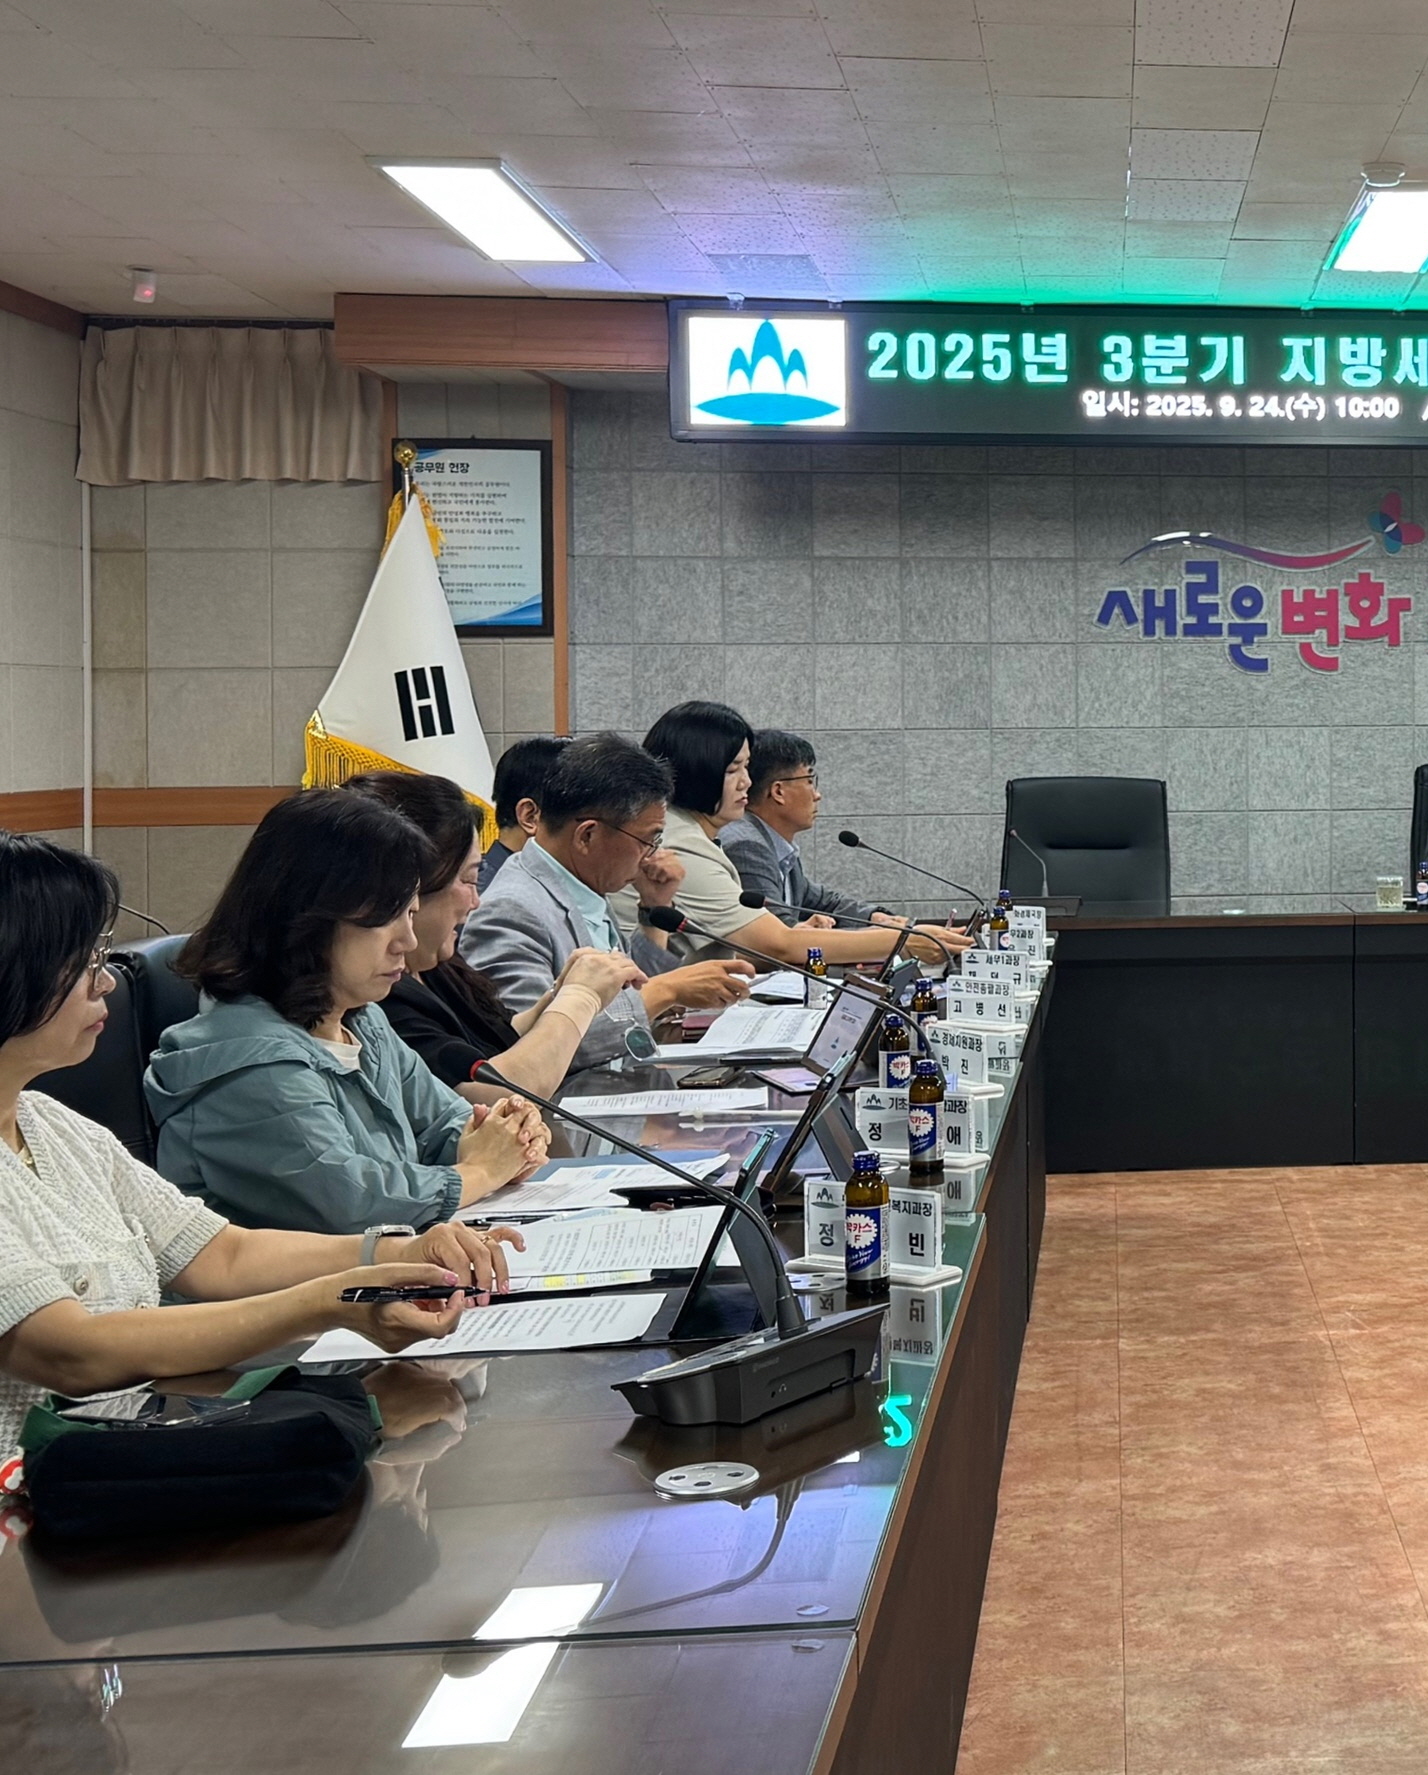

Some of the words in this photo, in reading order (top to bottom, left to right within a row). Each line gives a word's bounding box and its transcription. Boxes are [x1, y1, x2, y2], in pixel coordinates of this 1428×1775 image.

[866, 331, 1069, 384] 2025년
[1102, 333, 1247, 386] 3분기
[1082, 390, 1139, 417] 일시:
[1145, 395, 1213, 417] 2025.
[1219, 395, 1242, 417] 9.
[1249, 393, 1326, 421] 24.(수)
[1335, 396, 1399, 418] 10:00
[414, 462, 445, 473] 공무원
[449, 462, 470, 474] 헌장
[1095, 560, 1270, 674] 새로운
[1280, 571, 1411, 674] 변화
[1011, 929, 1034, 939] 무2과장
[868, 1122, 882, 1141] 정
[946, 1126, 961, 1145] 애
[818, 1223, 834, 1247] 정
[909, 1232, 924, 1257] 빈
[854, 1235, 861, 1243] F
